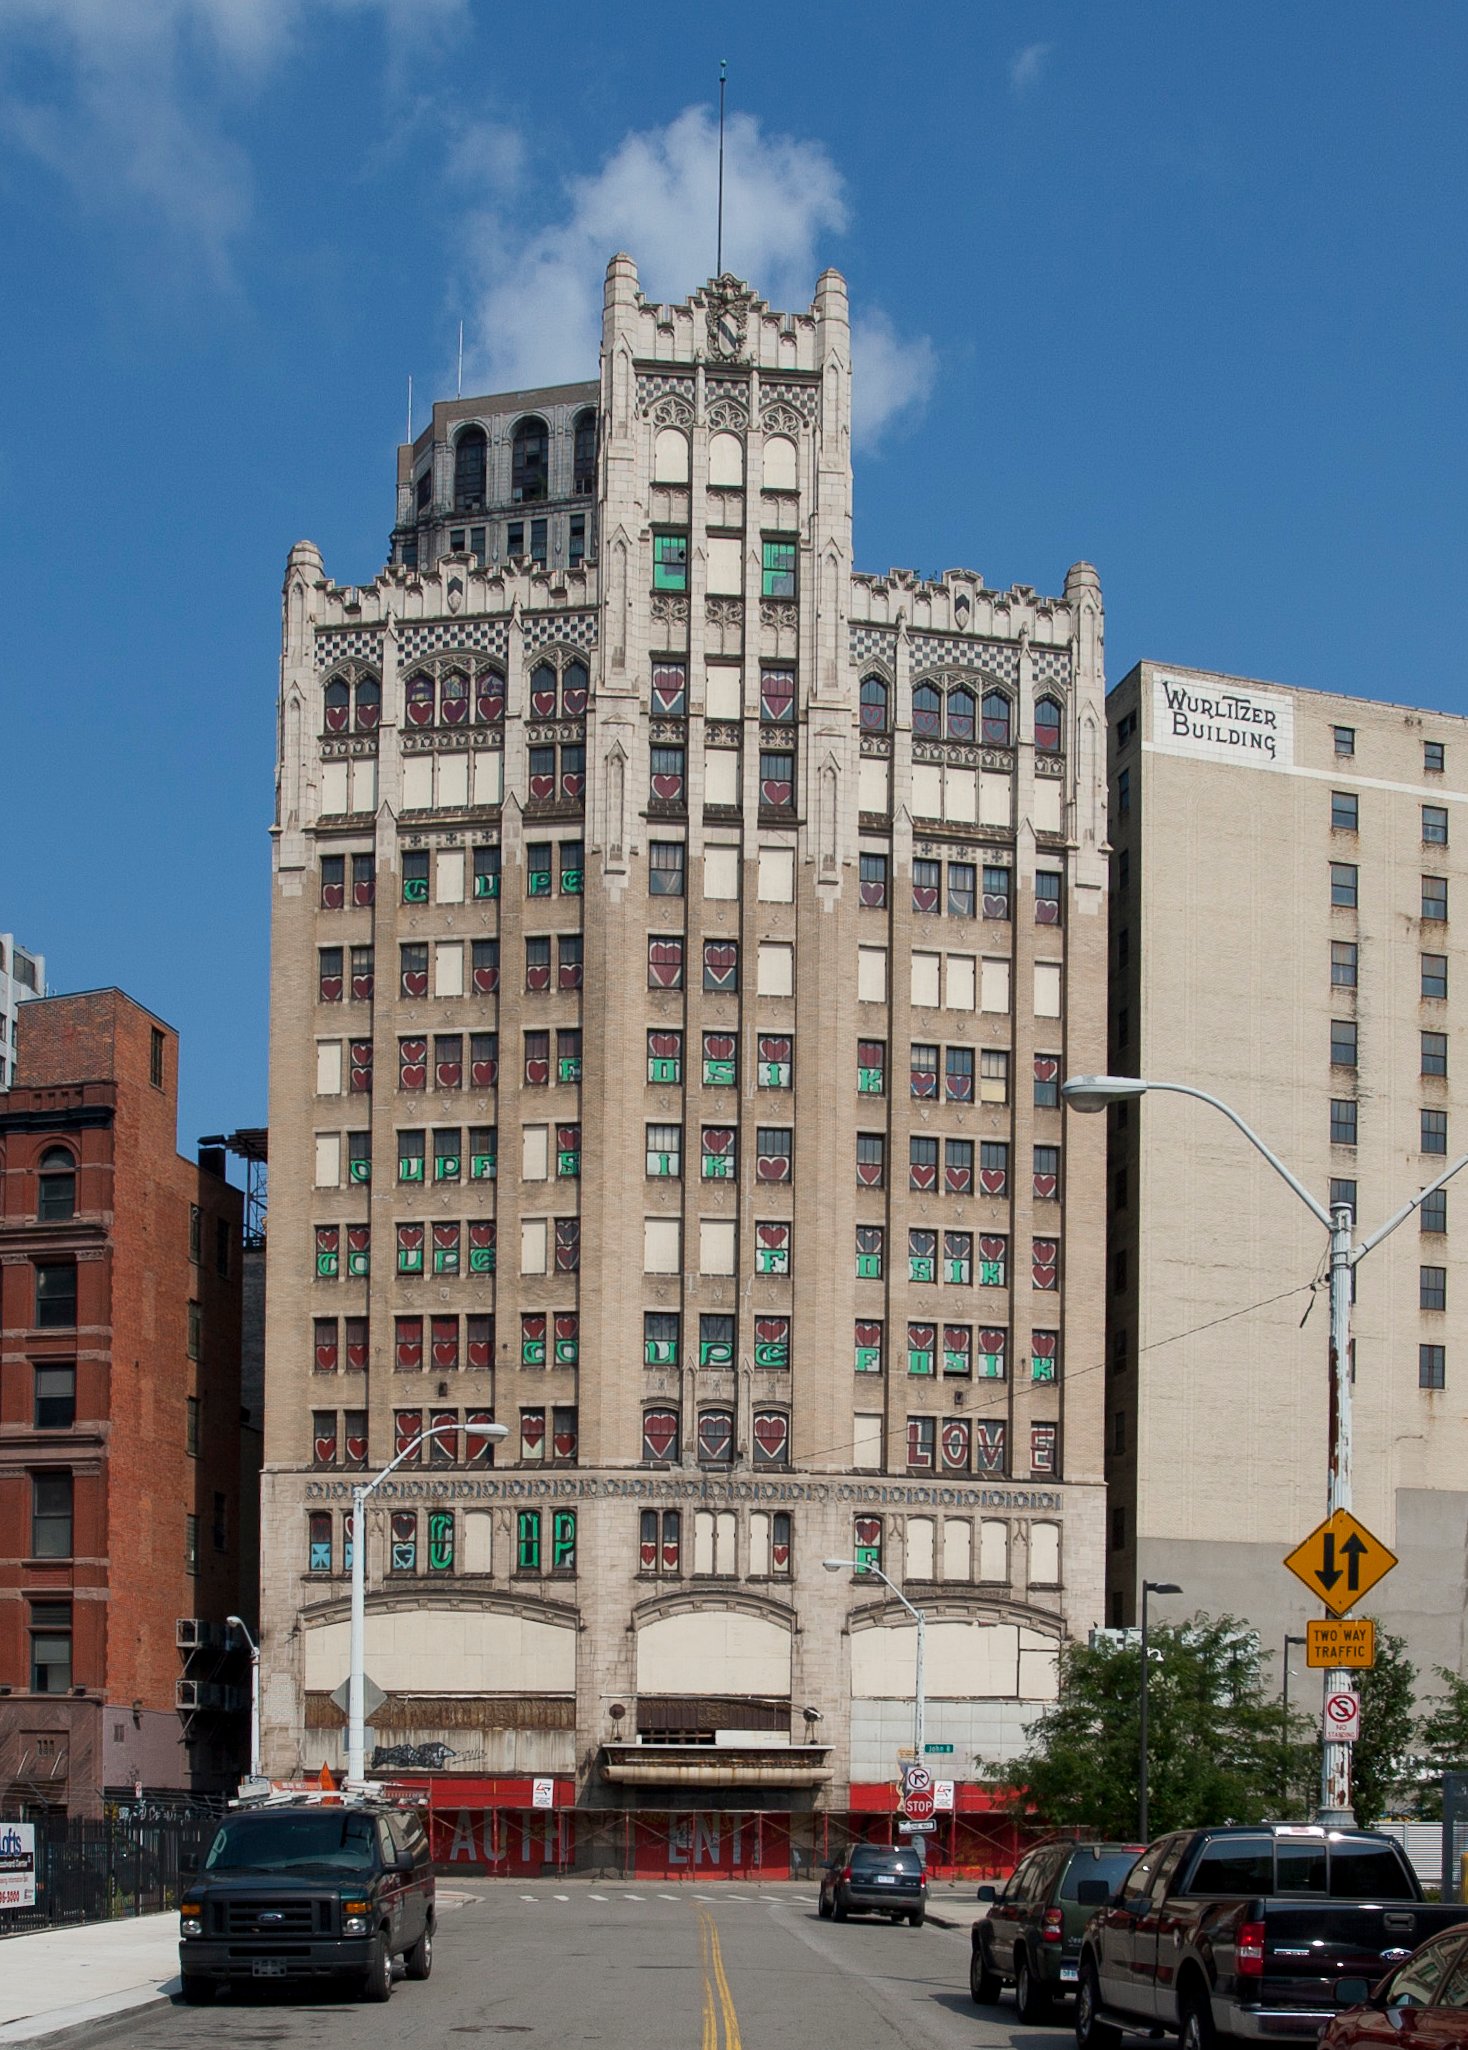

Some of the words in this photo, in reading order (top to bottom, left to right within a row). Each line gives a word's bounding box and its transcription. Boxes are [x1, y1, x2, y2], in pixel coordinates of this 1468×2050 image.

[1163, 681, 1276, 730] WURLITZER
[1172, 712, 1276, 760] BUILDING
[907, 1421, 1055, 1472] LOVE
[1314, 1629, 1338, 1642] TWO
[1343, 1629, 1366, 1641] WAY
[1315, 1645, 1365, 1658] TRAFFIC
[906, 1800, 933, 1813] STOP
[450, 1808, 569, 1862] AUTH
